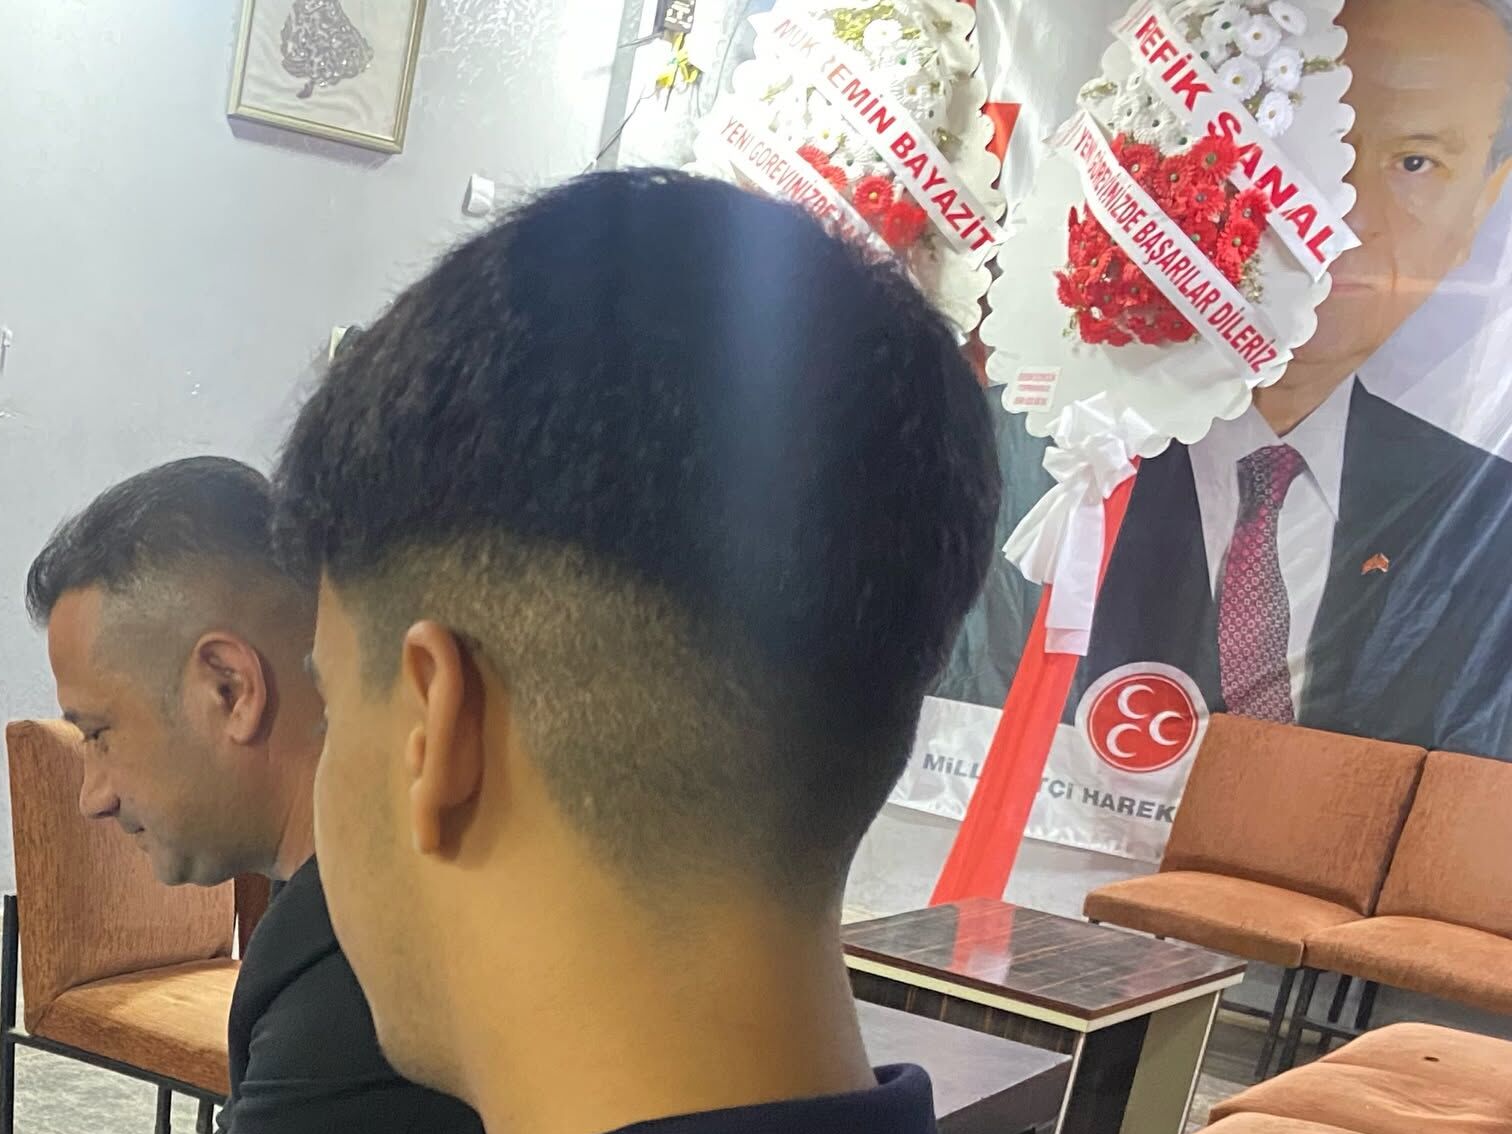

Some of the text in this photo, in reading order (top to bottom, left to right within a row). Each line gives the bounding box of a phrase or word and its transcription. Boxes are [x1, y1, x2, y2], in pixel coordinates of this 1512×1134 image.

[1135, 15, 1213, 112] REFİK
[890, 131, 997, 252] BAYAZİT
[1131, 220, 1222, 315] BAŞARILAR
[1207, 307, 1277, 373] DİLERİZ
